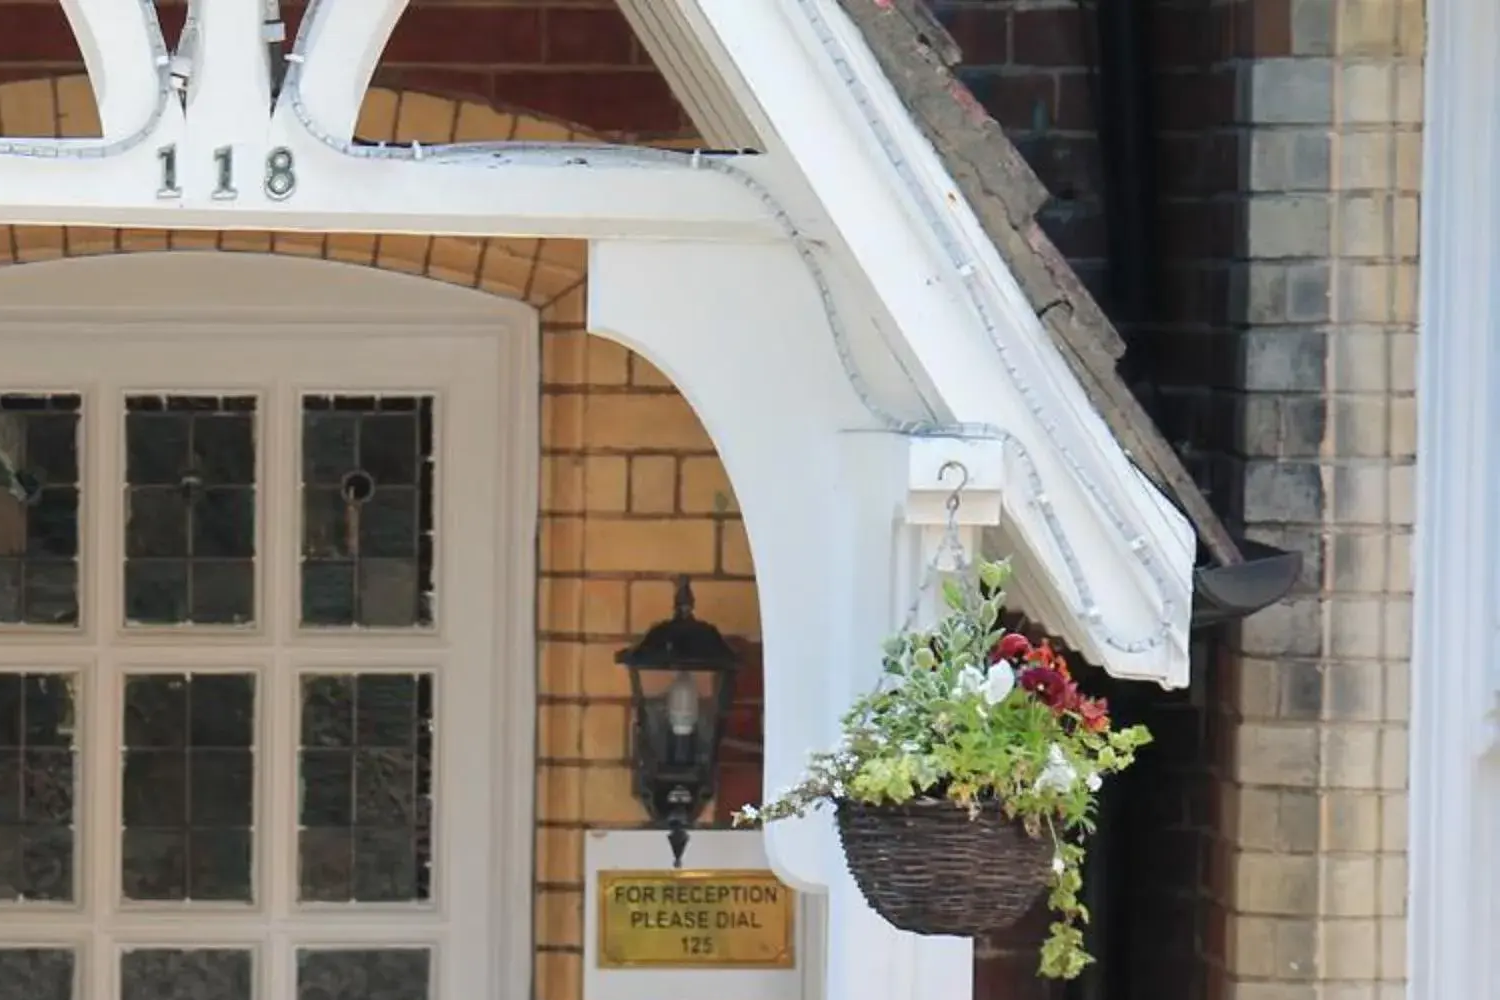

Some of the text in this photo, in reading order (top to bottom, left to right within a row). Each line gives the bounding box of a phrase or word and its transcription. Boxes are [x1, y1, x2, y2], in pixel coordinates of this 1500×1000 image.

[156, 145, 296, 201] 118
[614, 885, 777, 904] FOR RECEPTION
[631, 911, 763, 929] PLEASE DIAL
[681, 936, 712, 954] 125
